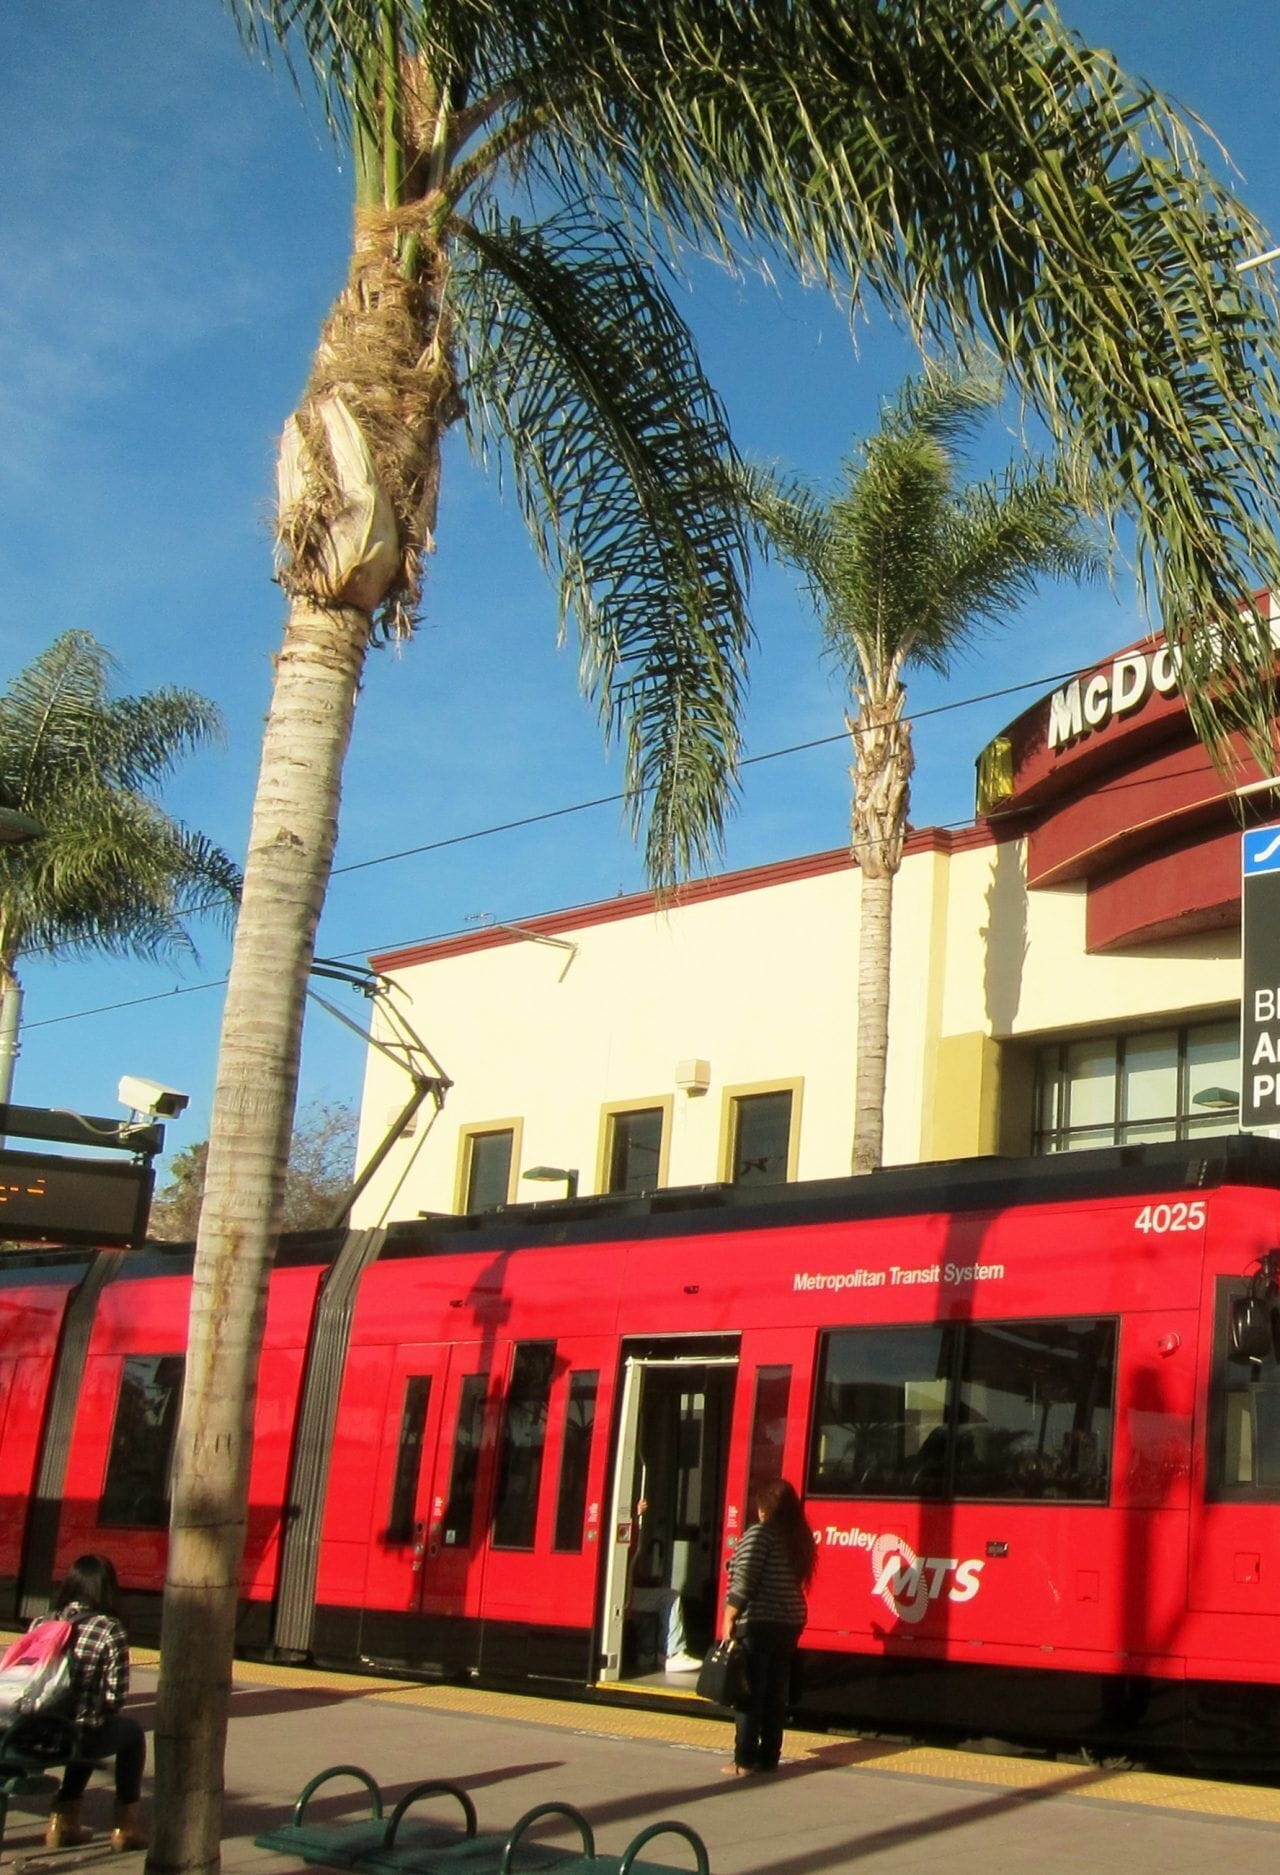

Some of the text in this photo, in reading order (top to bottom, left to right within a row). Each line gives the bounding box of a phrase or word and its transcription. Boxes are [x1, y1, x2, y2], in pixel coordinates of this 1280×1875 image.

[1134, 1202, 1206, 1234] 4025
[793, 1263, 1004, 1292] Metropolitan Transit System
[825, 1526, 877, 1551] Trolley
[871, 1555, 985, 1602] MTS
